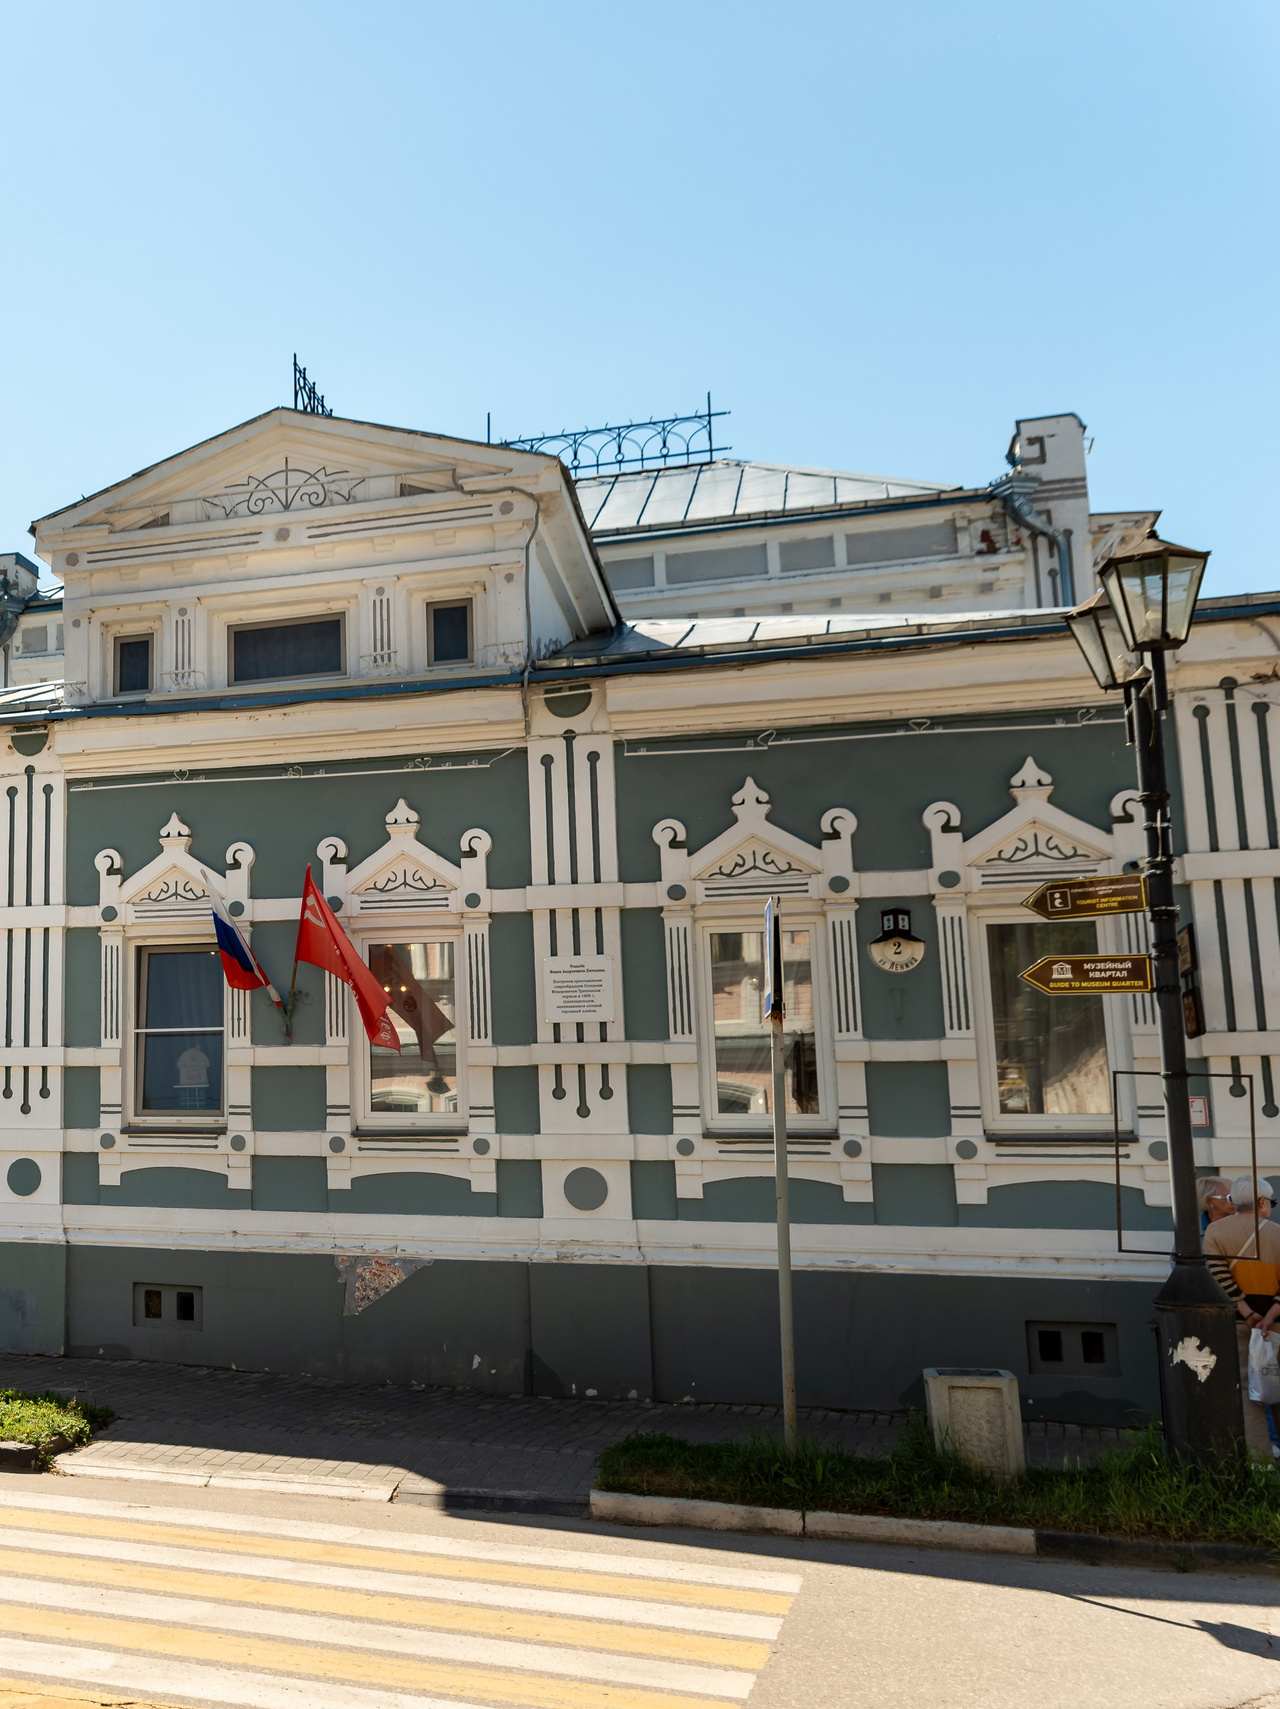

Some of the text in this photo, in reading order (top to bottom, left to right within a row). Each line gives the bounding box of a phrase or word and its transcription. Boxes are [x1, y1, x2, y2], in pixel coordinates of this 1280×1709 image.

[1100, 895, 1138, 903] INFORMATION
[893, 941, 902, 955] 2
[889, 957, 919, 970] ЛЕНИНА
[1083, 961, 1132, 970] МУЗЕЙНЫЙ
[1089, 970, 1128, 978] КВАРТАЛ
